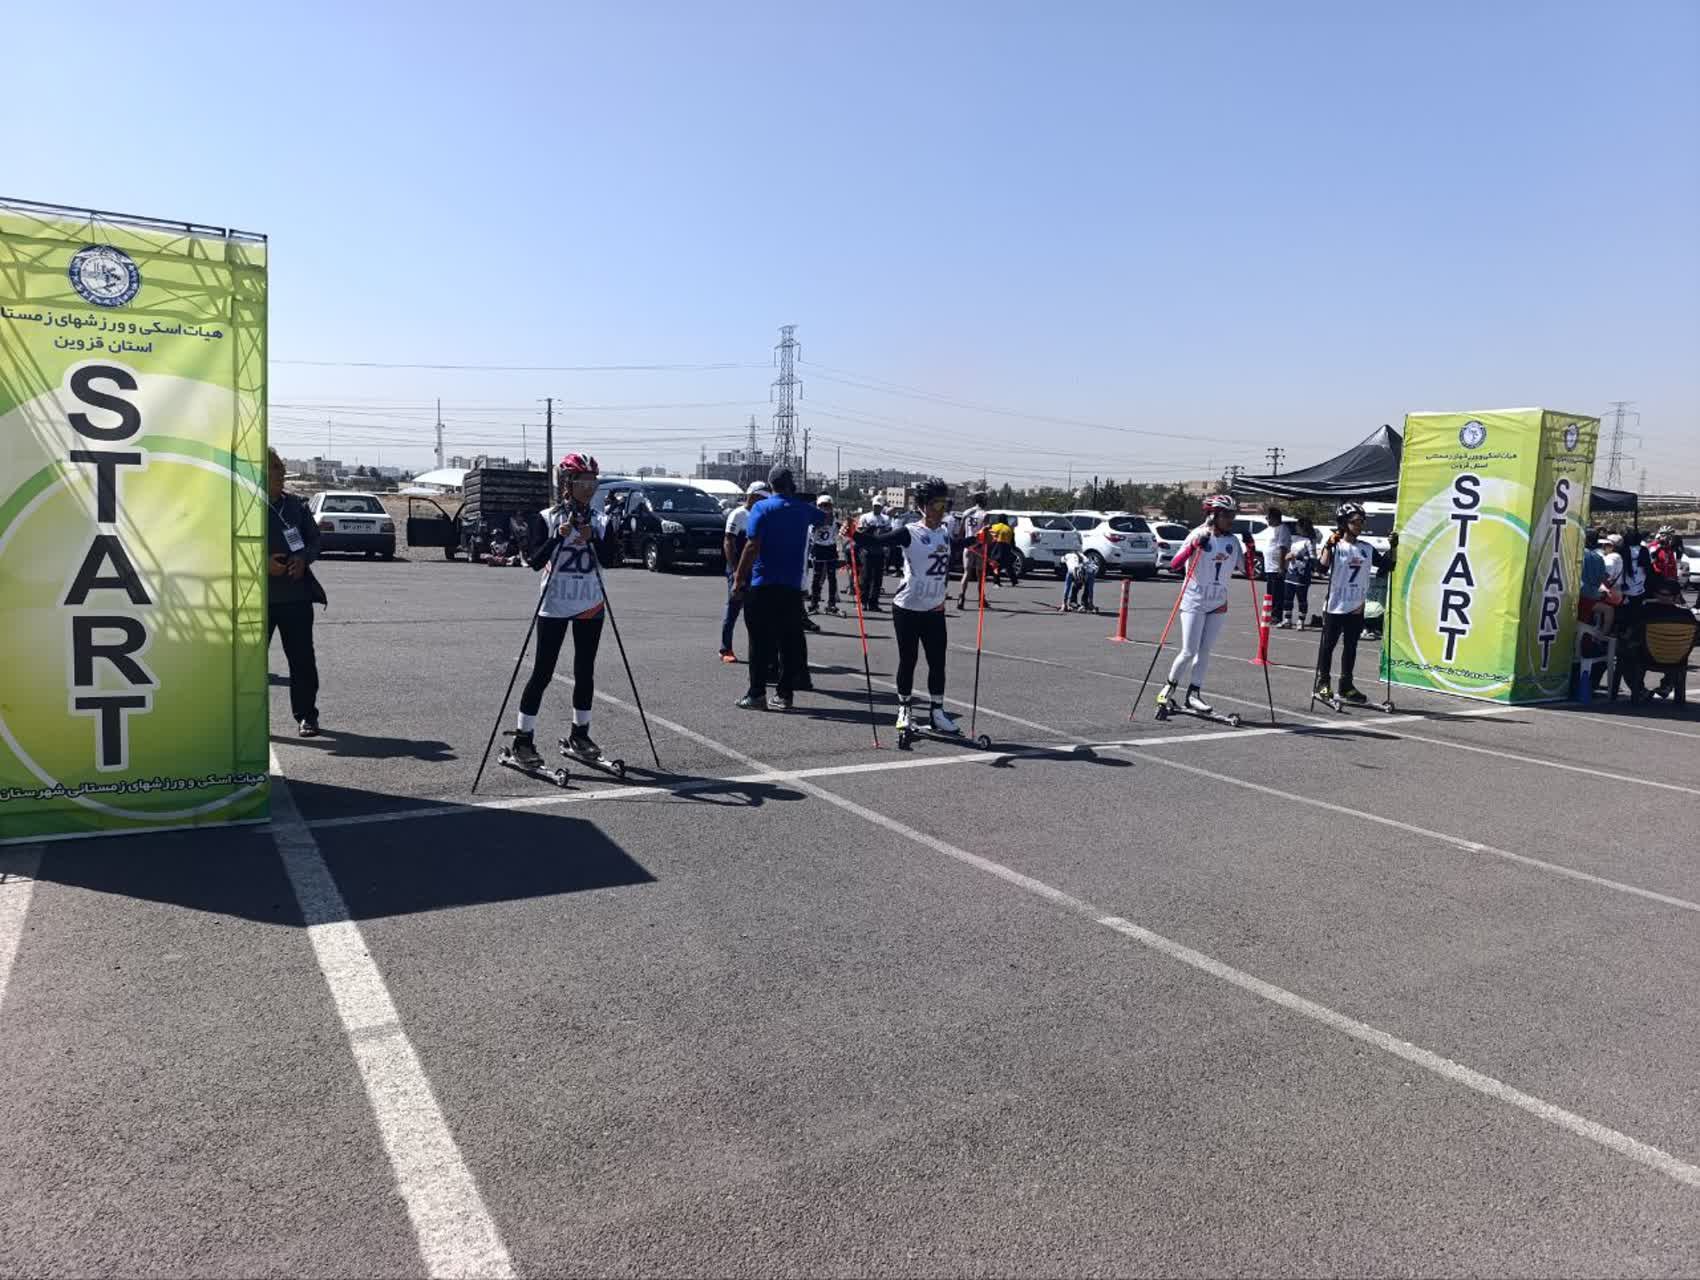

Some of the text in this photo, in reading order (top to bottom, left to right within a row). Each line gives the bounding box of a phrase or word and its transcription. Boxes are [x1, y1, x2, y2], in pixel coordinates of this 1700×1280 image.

[139, 321, 182, 336] اسکی
[54, 335, 153, 353] استان قزوین
[64, 364, 154, 767] START
[558, 546, 593, 574] 20
[926, 554, 948, 576] 28
[1438, 474, 1481, 661] START
[1215, 562, 1222, 581] 1
[1348, 565, 1361, 583] 7
[1538, 478, 1571, 669] START
